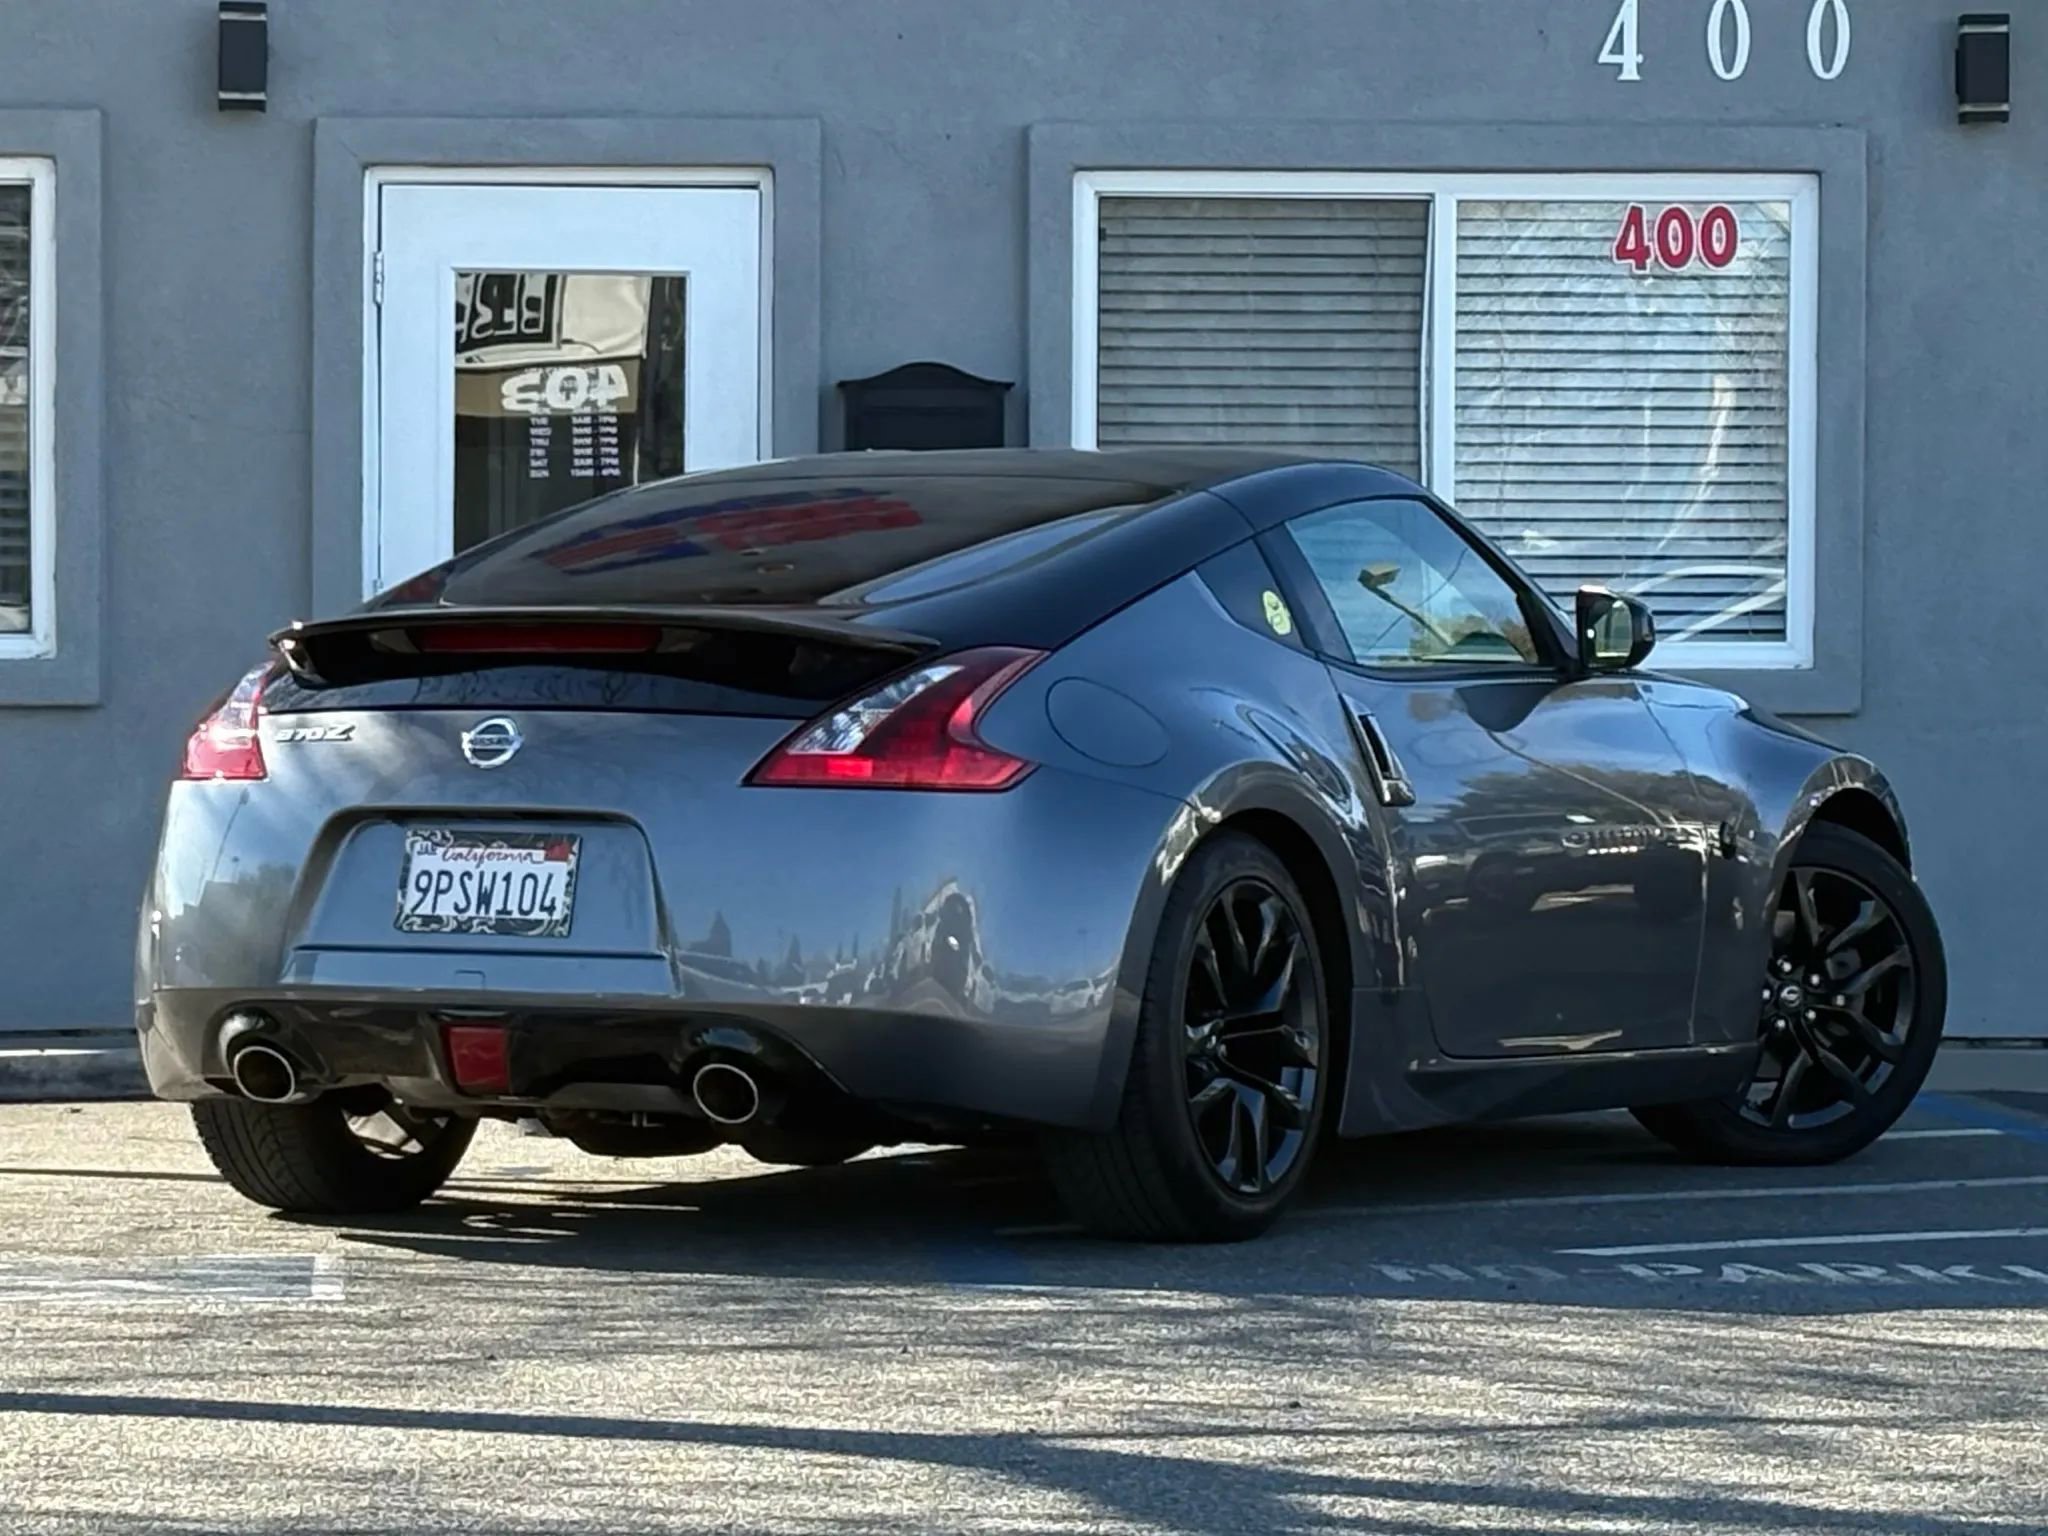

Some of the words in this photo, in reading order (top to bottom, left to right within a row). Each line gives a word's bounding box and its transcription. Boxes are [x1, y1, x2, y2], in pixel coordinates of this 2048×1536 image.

[1613, 202, 1740, 274] 400
[441, 847, 545, 868] California
[411, 869, 557, 916] 9PSW104
